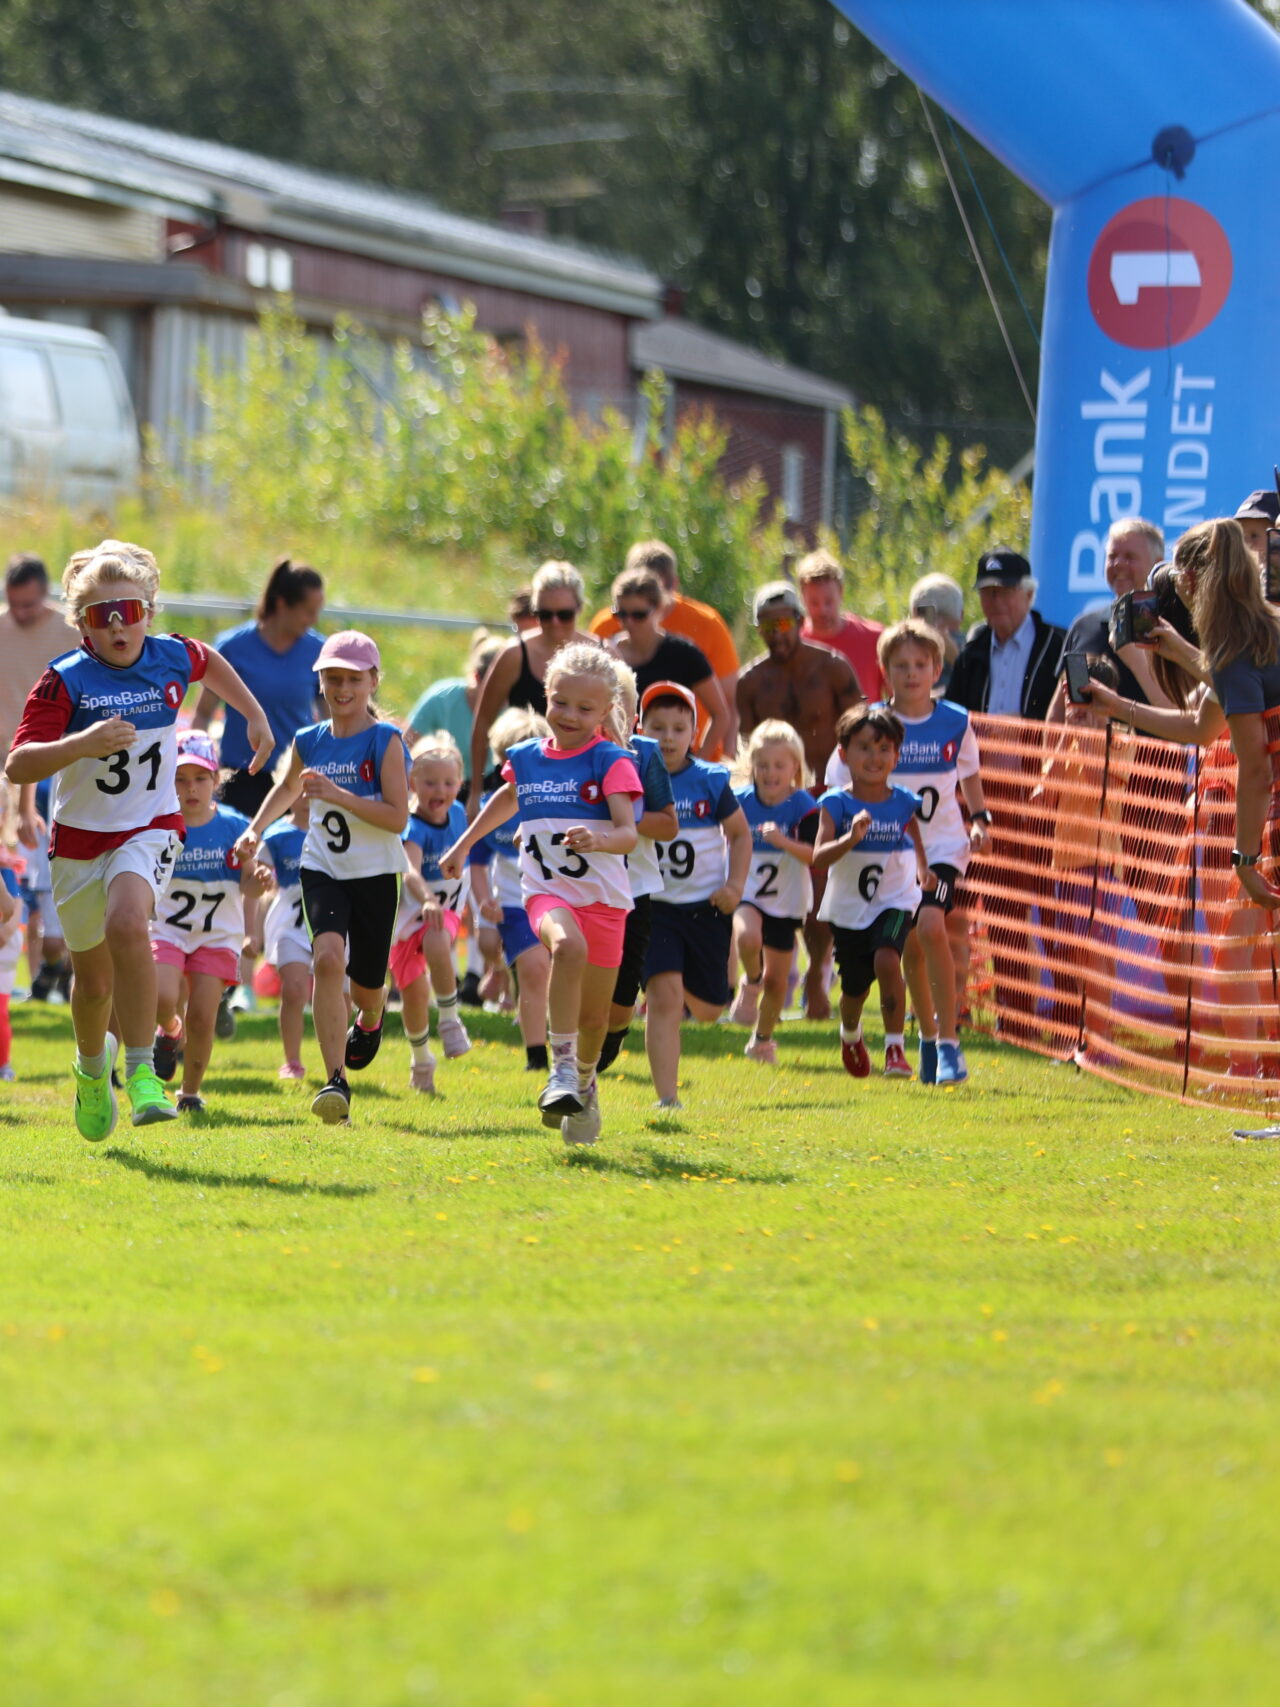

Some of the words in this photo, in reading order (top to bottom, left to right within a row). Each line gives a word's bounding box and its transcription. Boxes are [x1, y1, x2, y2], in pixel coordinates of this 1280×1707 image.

[1110, 250, 1202, 305] 1
[80, 686, 162, 710] SpareBank
[168, 685, 179, 704] 1
[101, 703, 164, 718] ØSTLANDET
[95, 741, 162, 795] 31
[516, 778, 579, 797] pareBank
[588, 785, 598, 800] 1
[916, 786, 939, 823] 0
[322, 810, 351, 853] 9
[525, 832, 589, 880] 13
[754, 863, 779, 898] 2
[858, 864, 884, 902] 6
[935, 879, 949, 903] 10
[165, 890, 225, 932] 27
